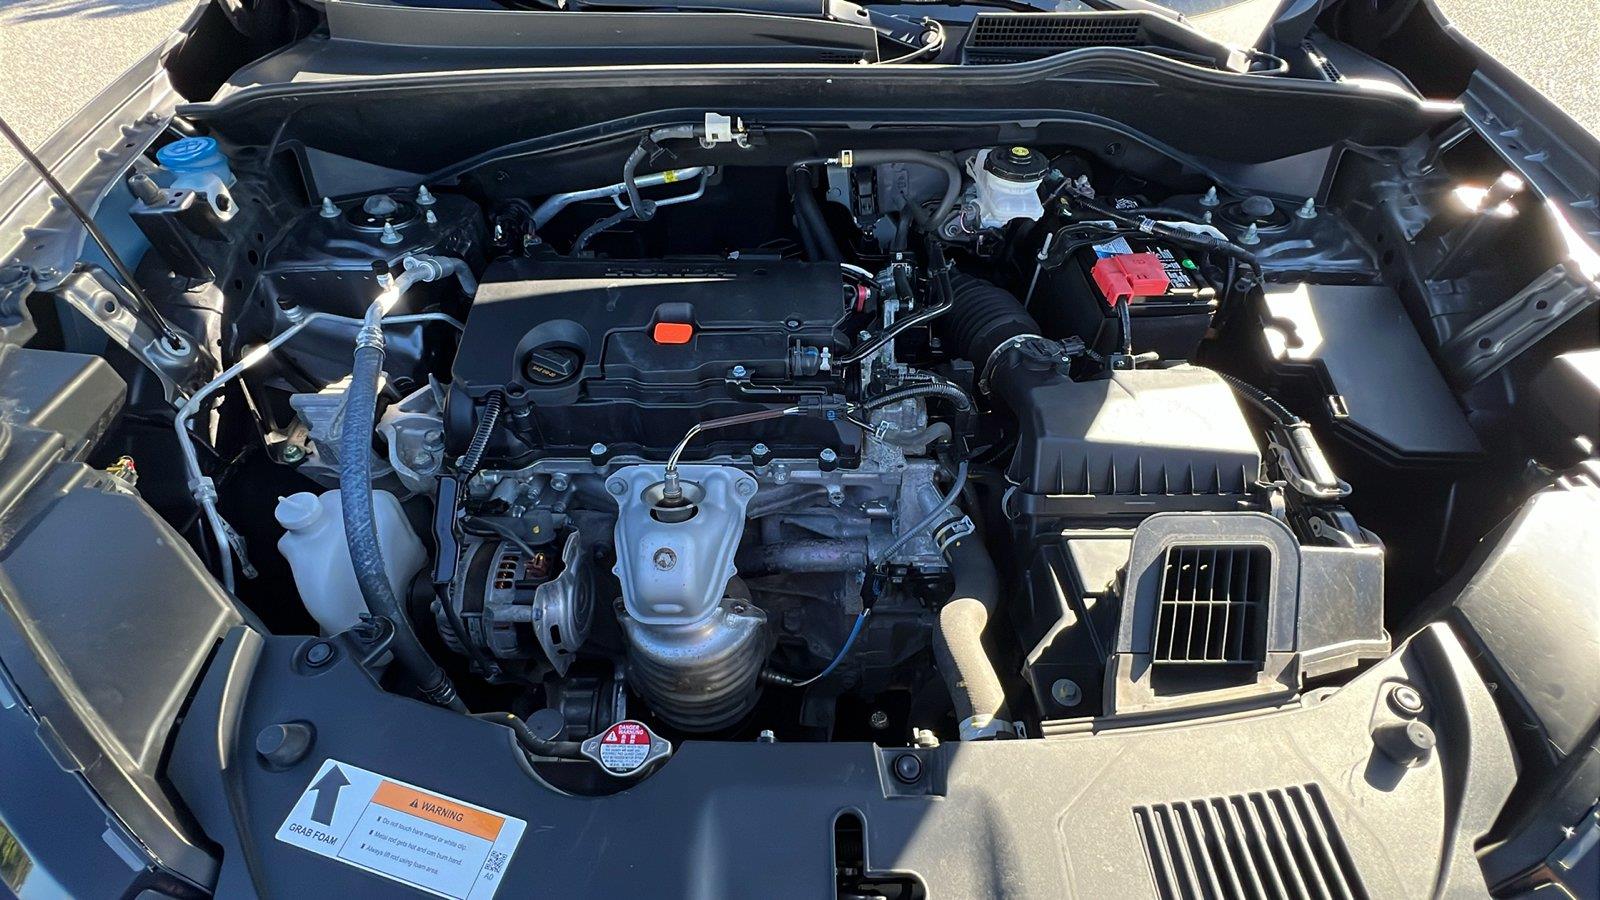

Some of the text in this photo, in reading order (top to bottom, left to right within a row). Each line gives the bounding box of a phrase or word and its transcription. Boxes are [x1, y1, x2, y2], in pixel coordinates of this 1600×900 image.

[421, 802, 464, 822] WARNING
[289, 823, 338, 845] GRAB FOAM
[383, 817, 390, 825] Do
[390, 820, 399, 828] not
[398, 823, 411, 832] touch
[411, 827, 424, 836] bare
[423, 831, 439, 841] metal
[444, 839, 457, 848] white
[366, 844, 384, 856] Always
[399, 857, 413, 868] using
[412, 861, 426, 870] foam
[374, 831, 388, 841] Metal
[387, 834, 397, 843] rod
[396, 840, 408, 849] gets
[407, 843, 417, 851] hot
[416, 846, 427, 854] and
[427, 849, 437, 857] can
[436, 852, 449, 861] burn
